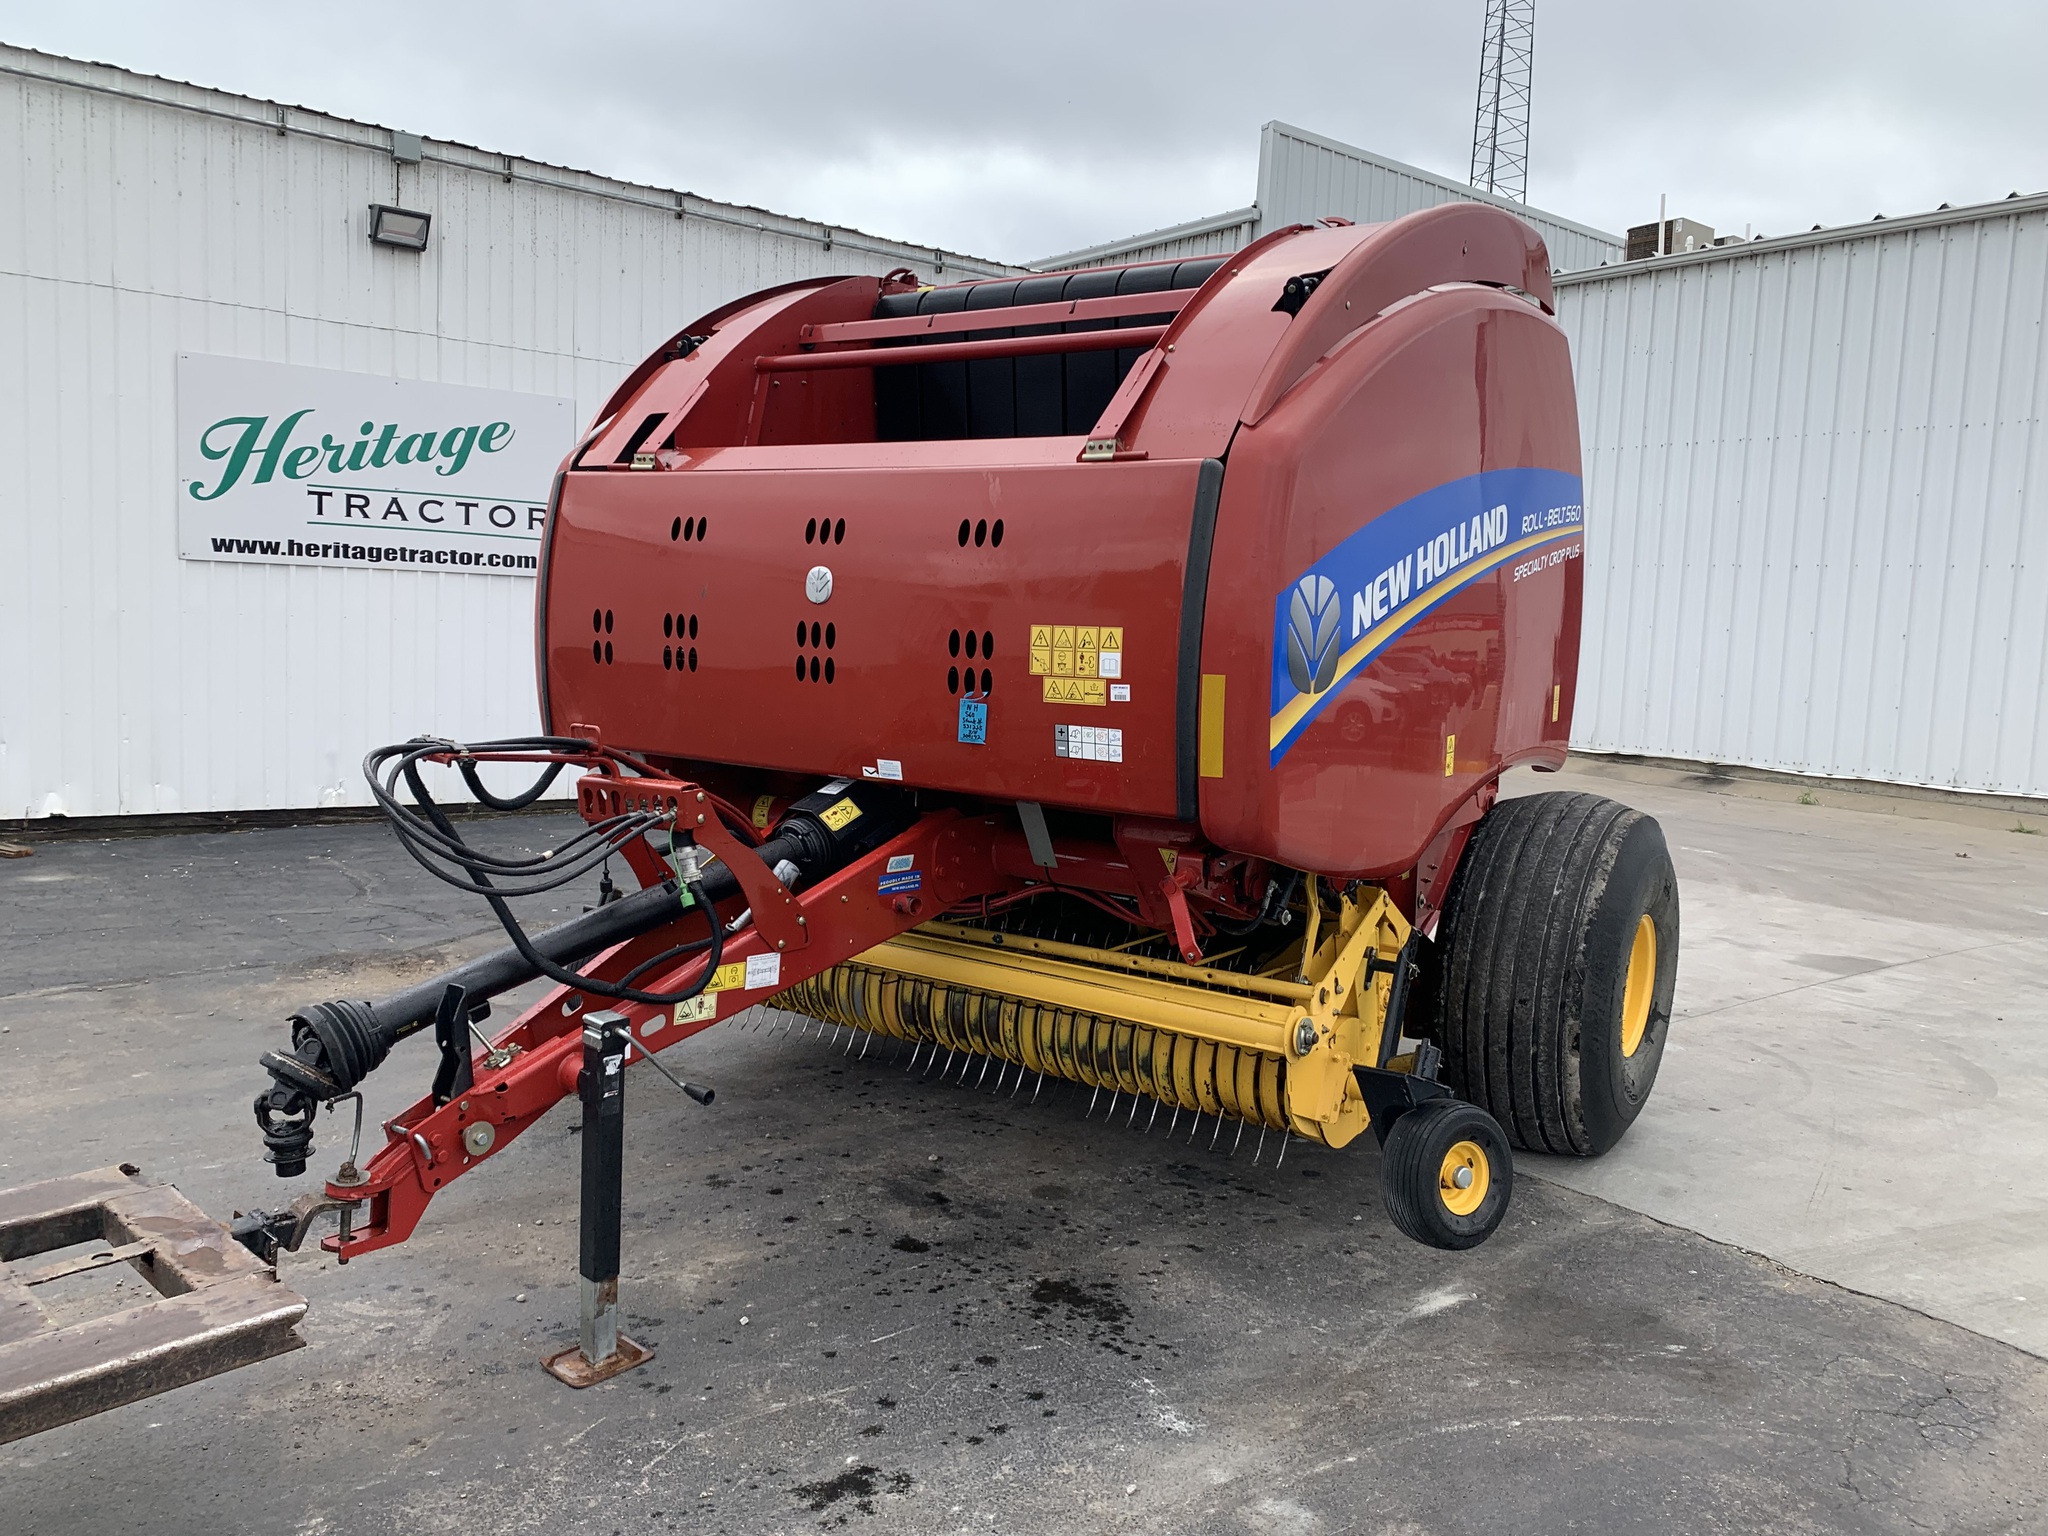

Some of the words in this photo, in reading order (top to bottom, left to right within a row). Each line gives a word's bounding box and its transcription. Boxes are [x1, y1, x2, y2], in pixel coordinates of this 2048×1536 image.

[189, 409, 516, 501] Heritage
[307, 489, 548, 530] TRACTOR
[1565, 504, 1581, 523] 560
[211, 537, 538, 569] www.heritagetractor.com
[1352, 553, 1413, 640] NEW
[1416, 504, 1508, 590] HOLLAND
[1513, 554, 1549, 583] SPECIALTY
[1549, 548, 1566, 567] CROP
[1565, 543, 1580, 562] PLUS
